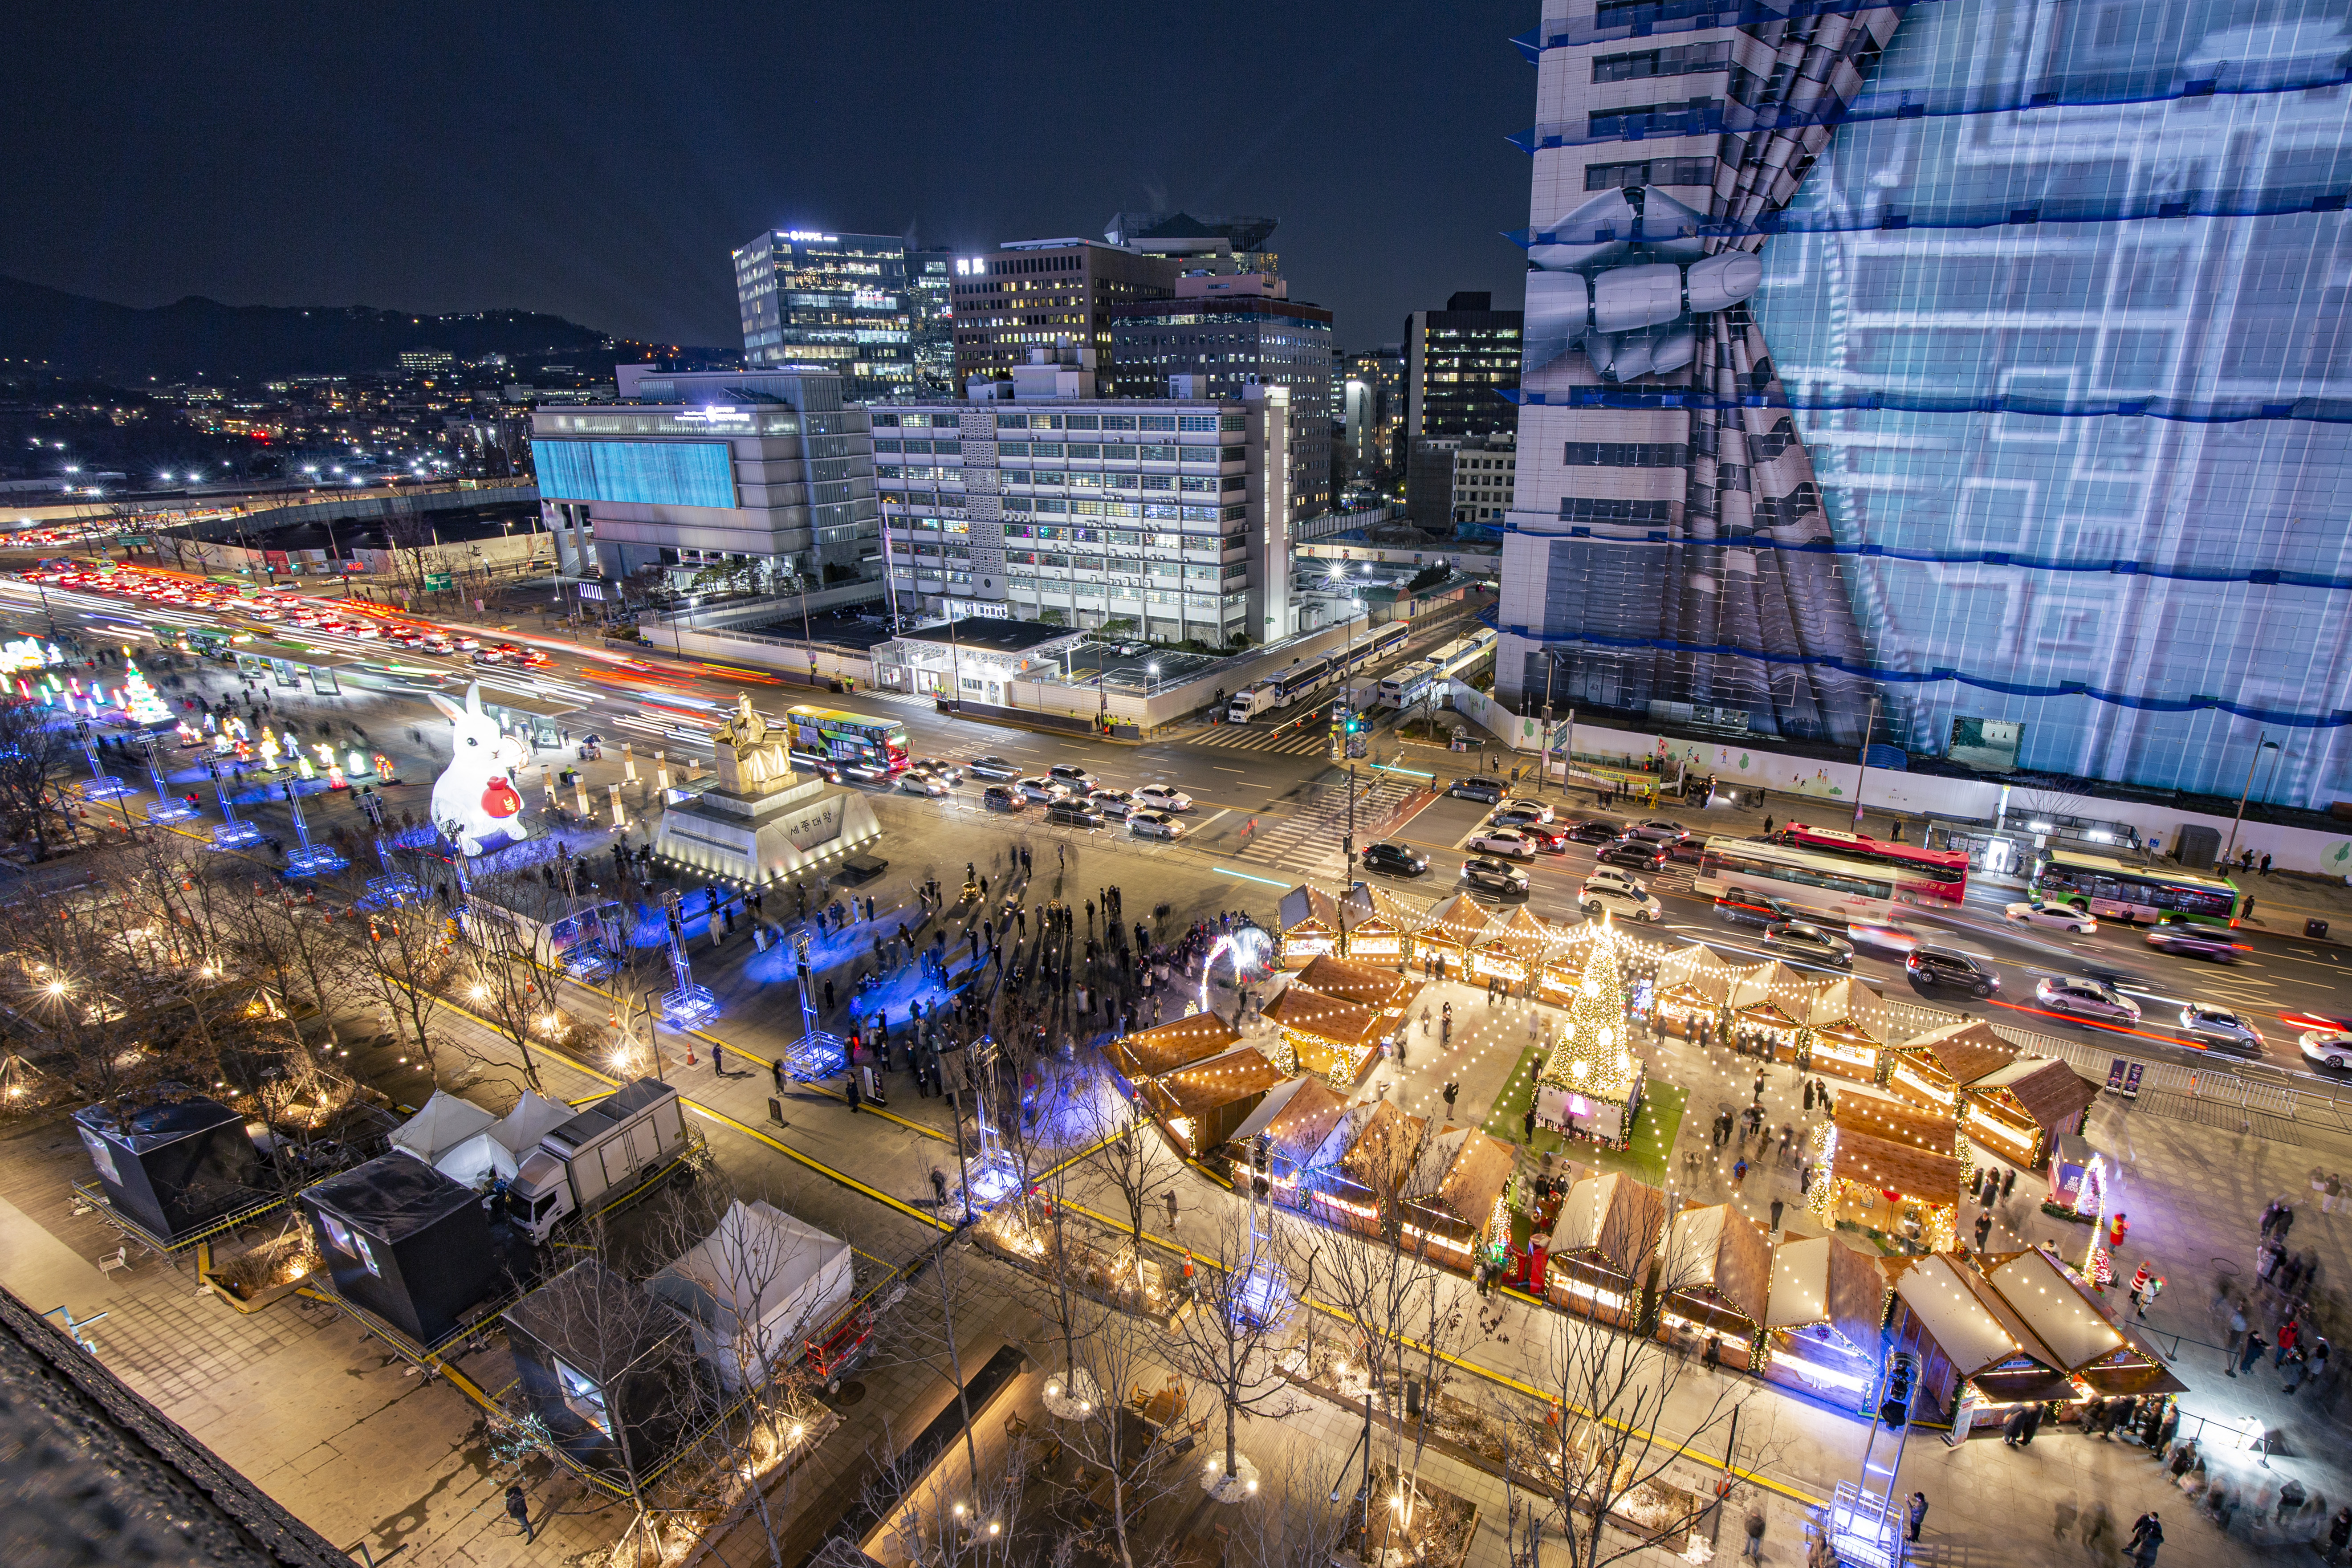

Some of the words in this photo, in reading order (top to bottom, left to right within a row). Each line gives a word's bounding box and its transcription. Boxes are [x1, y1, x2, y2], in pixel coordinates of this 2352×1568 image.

[503, 796, 516, 811] 복
[791, 811, 832, 835] 세종대왕
[1660, 863, 1699, 878] 50
[1652, 877, 1693, 892] 50
[1912, 879, 1947, 892] 하나관광
